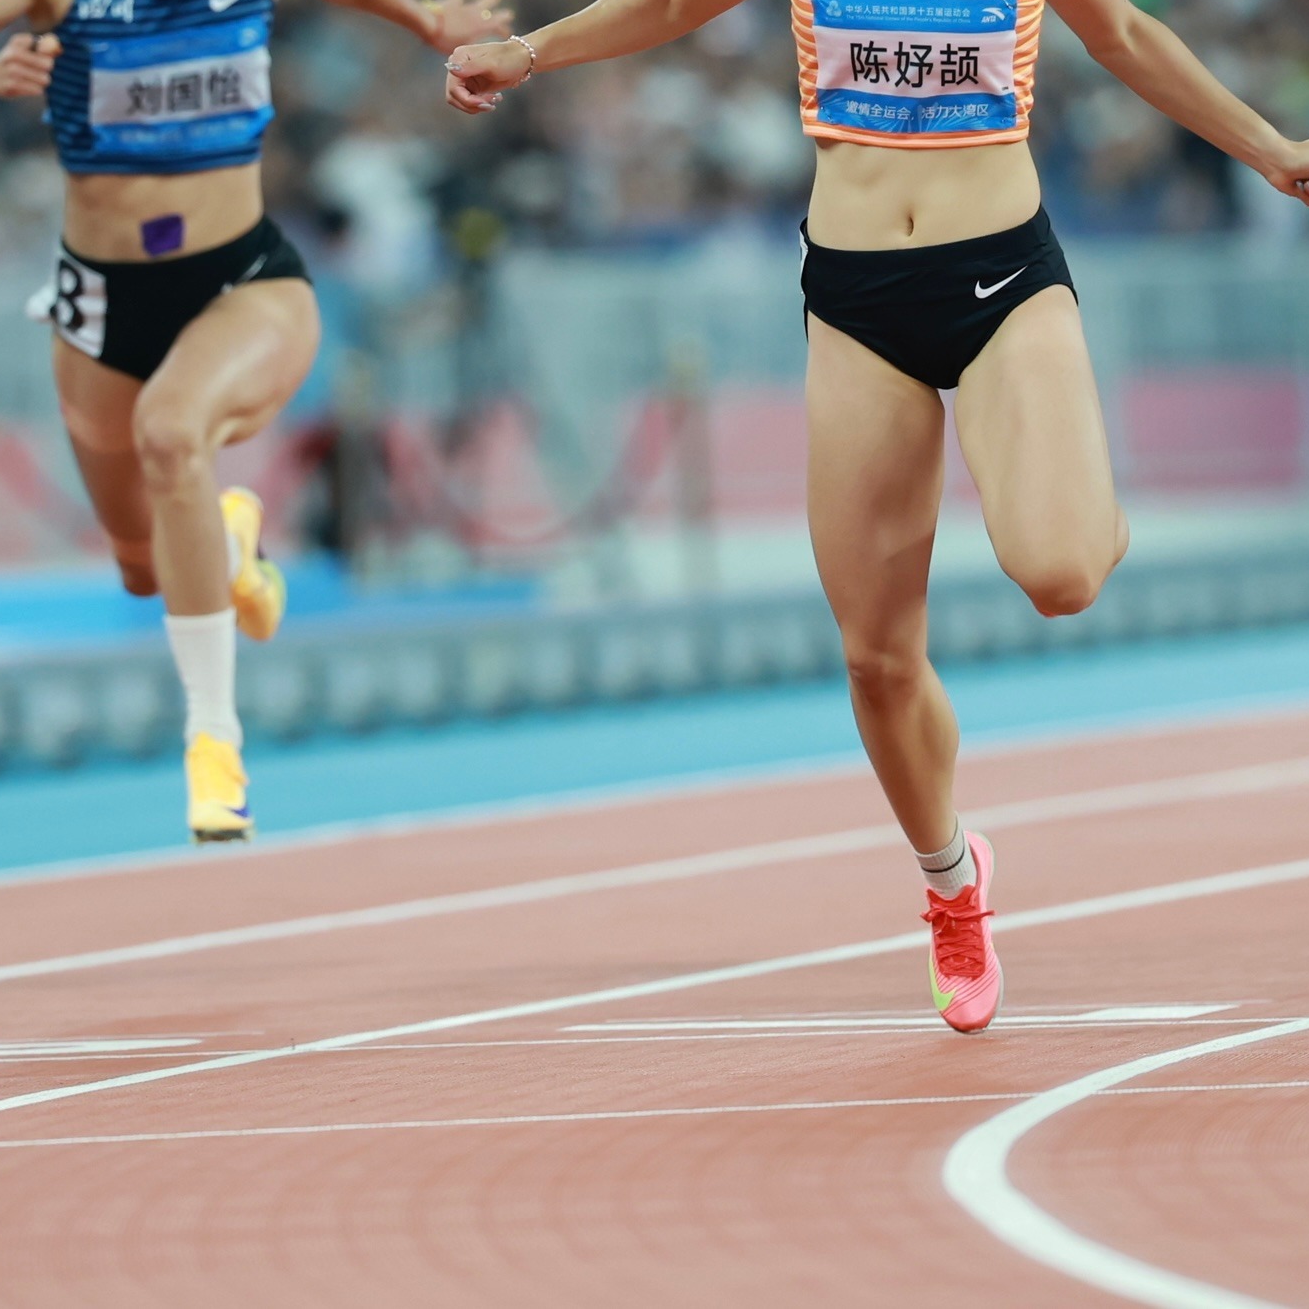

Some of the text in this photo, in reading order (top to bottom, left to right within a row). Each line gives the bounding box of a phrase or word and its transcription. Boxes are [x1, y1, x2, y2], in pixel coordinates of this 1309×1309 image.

[845, 4, 971, 18] 中华人民共和国第十五届运动会
[849, 40, 981, 89] 陈妤颉
